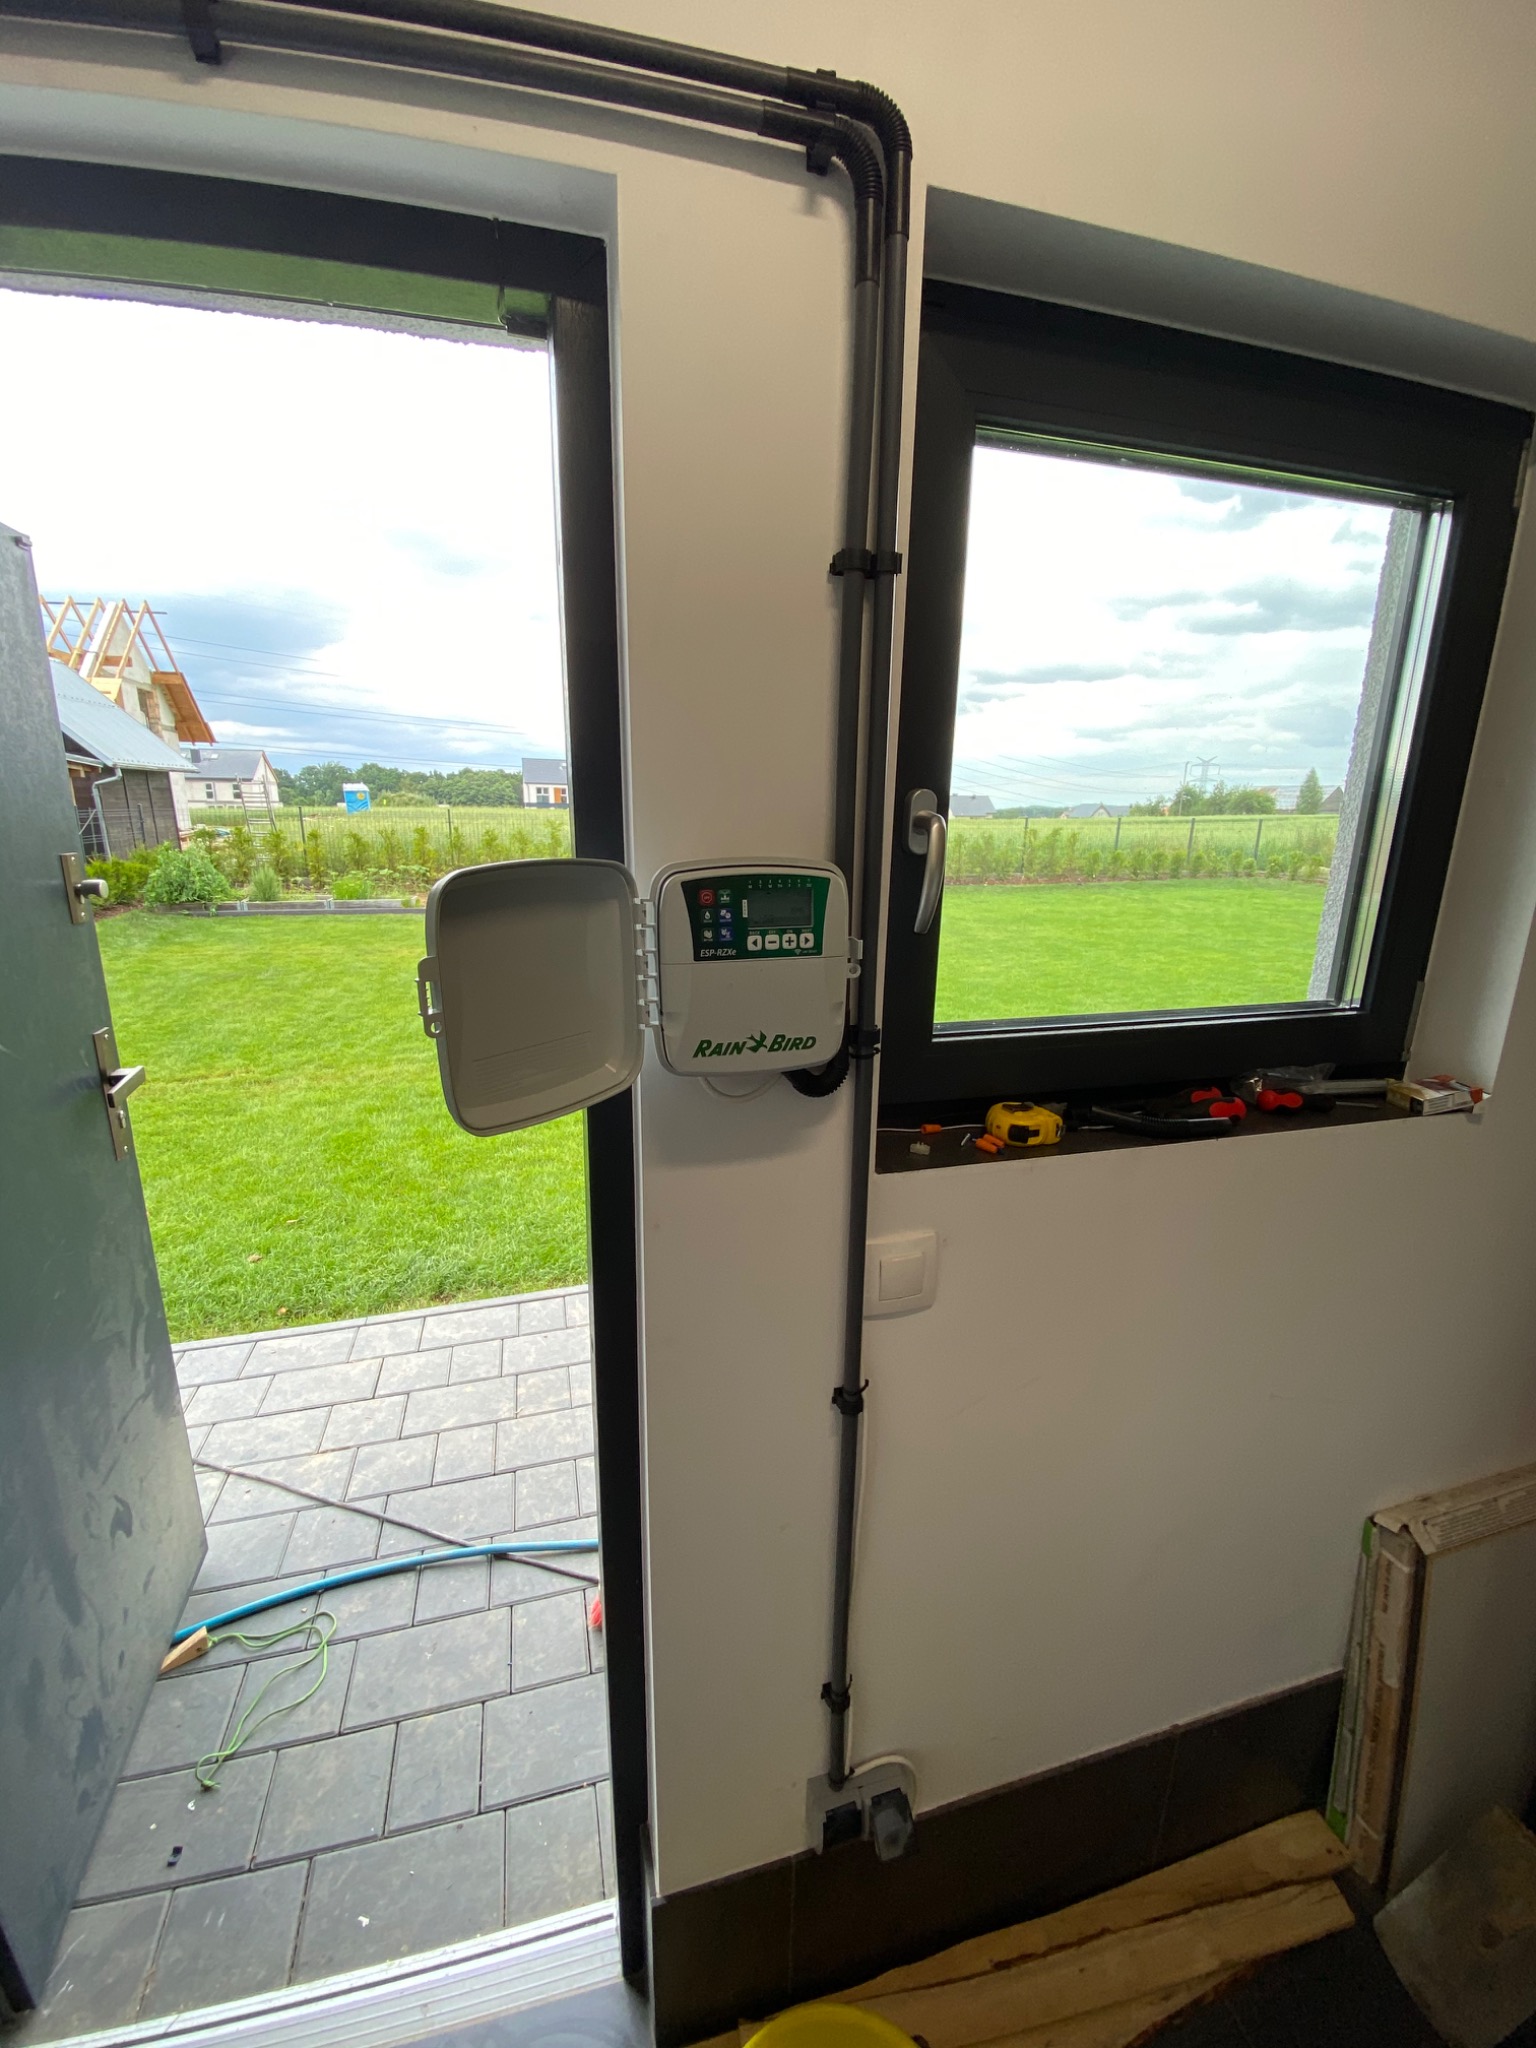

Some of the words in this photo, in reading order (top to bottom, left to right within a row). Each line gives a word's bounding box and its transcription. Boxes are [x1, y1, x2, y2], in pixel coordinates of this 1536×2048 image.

[700, 948, 737, 958] ESP-RZXe
[692, 1039, 747, 1058] RAIN
[767, 1034, 817, 1053] BIRD
